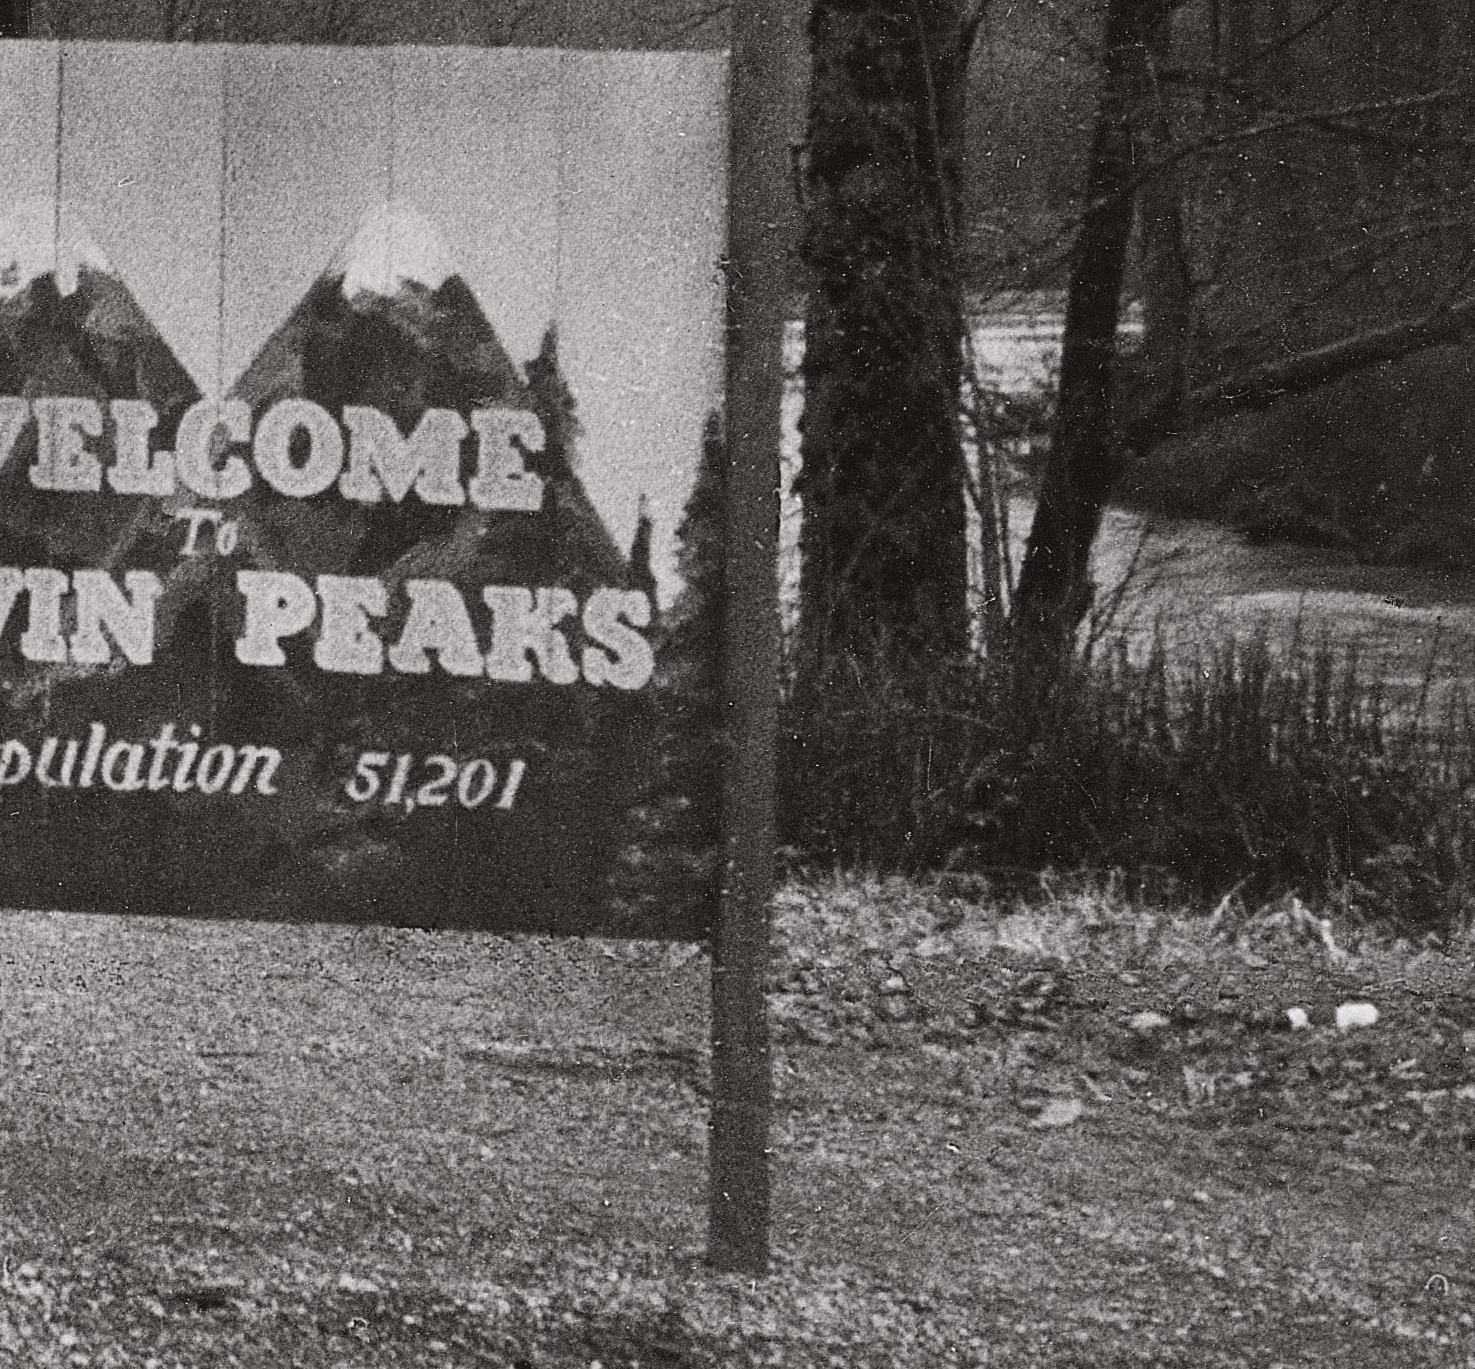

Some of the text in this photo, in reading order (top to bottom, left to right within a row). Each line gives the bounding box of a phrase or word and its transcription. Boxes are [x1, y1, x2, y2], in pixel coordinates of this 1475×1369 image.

[175, 508, 239, 557] To
[235, 569, 656, 690] PEAKS
[345, 751, 527, 816] 51,201
